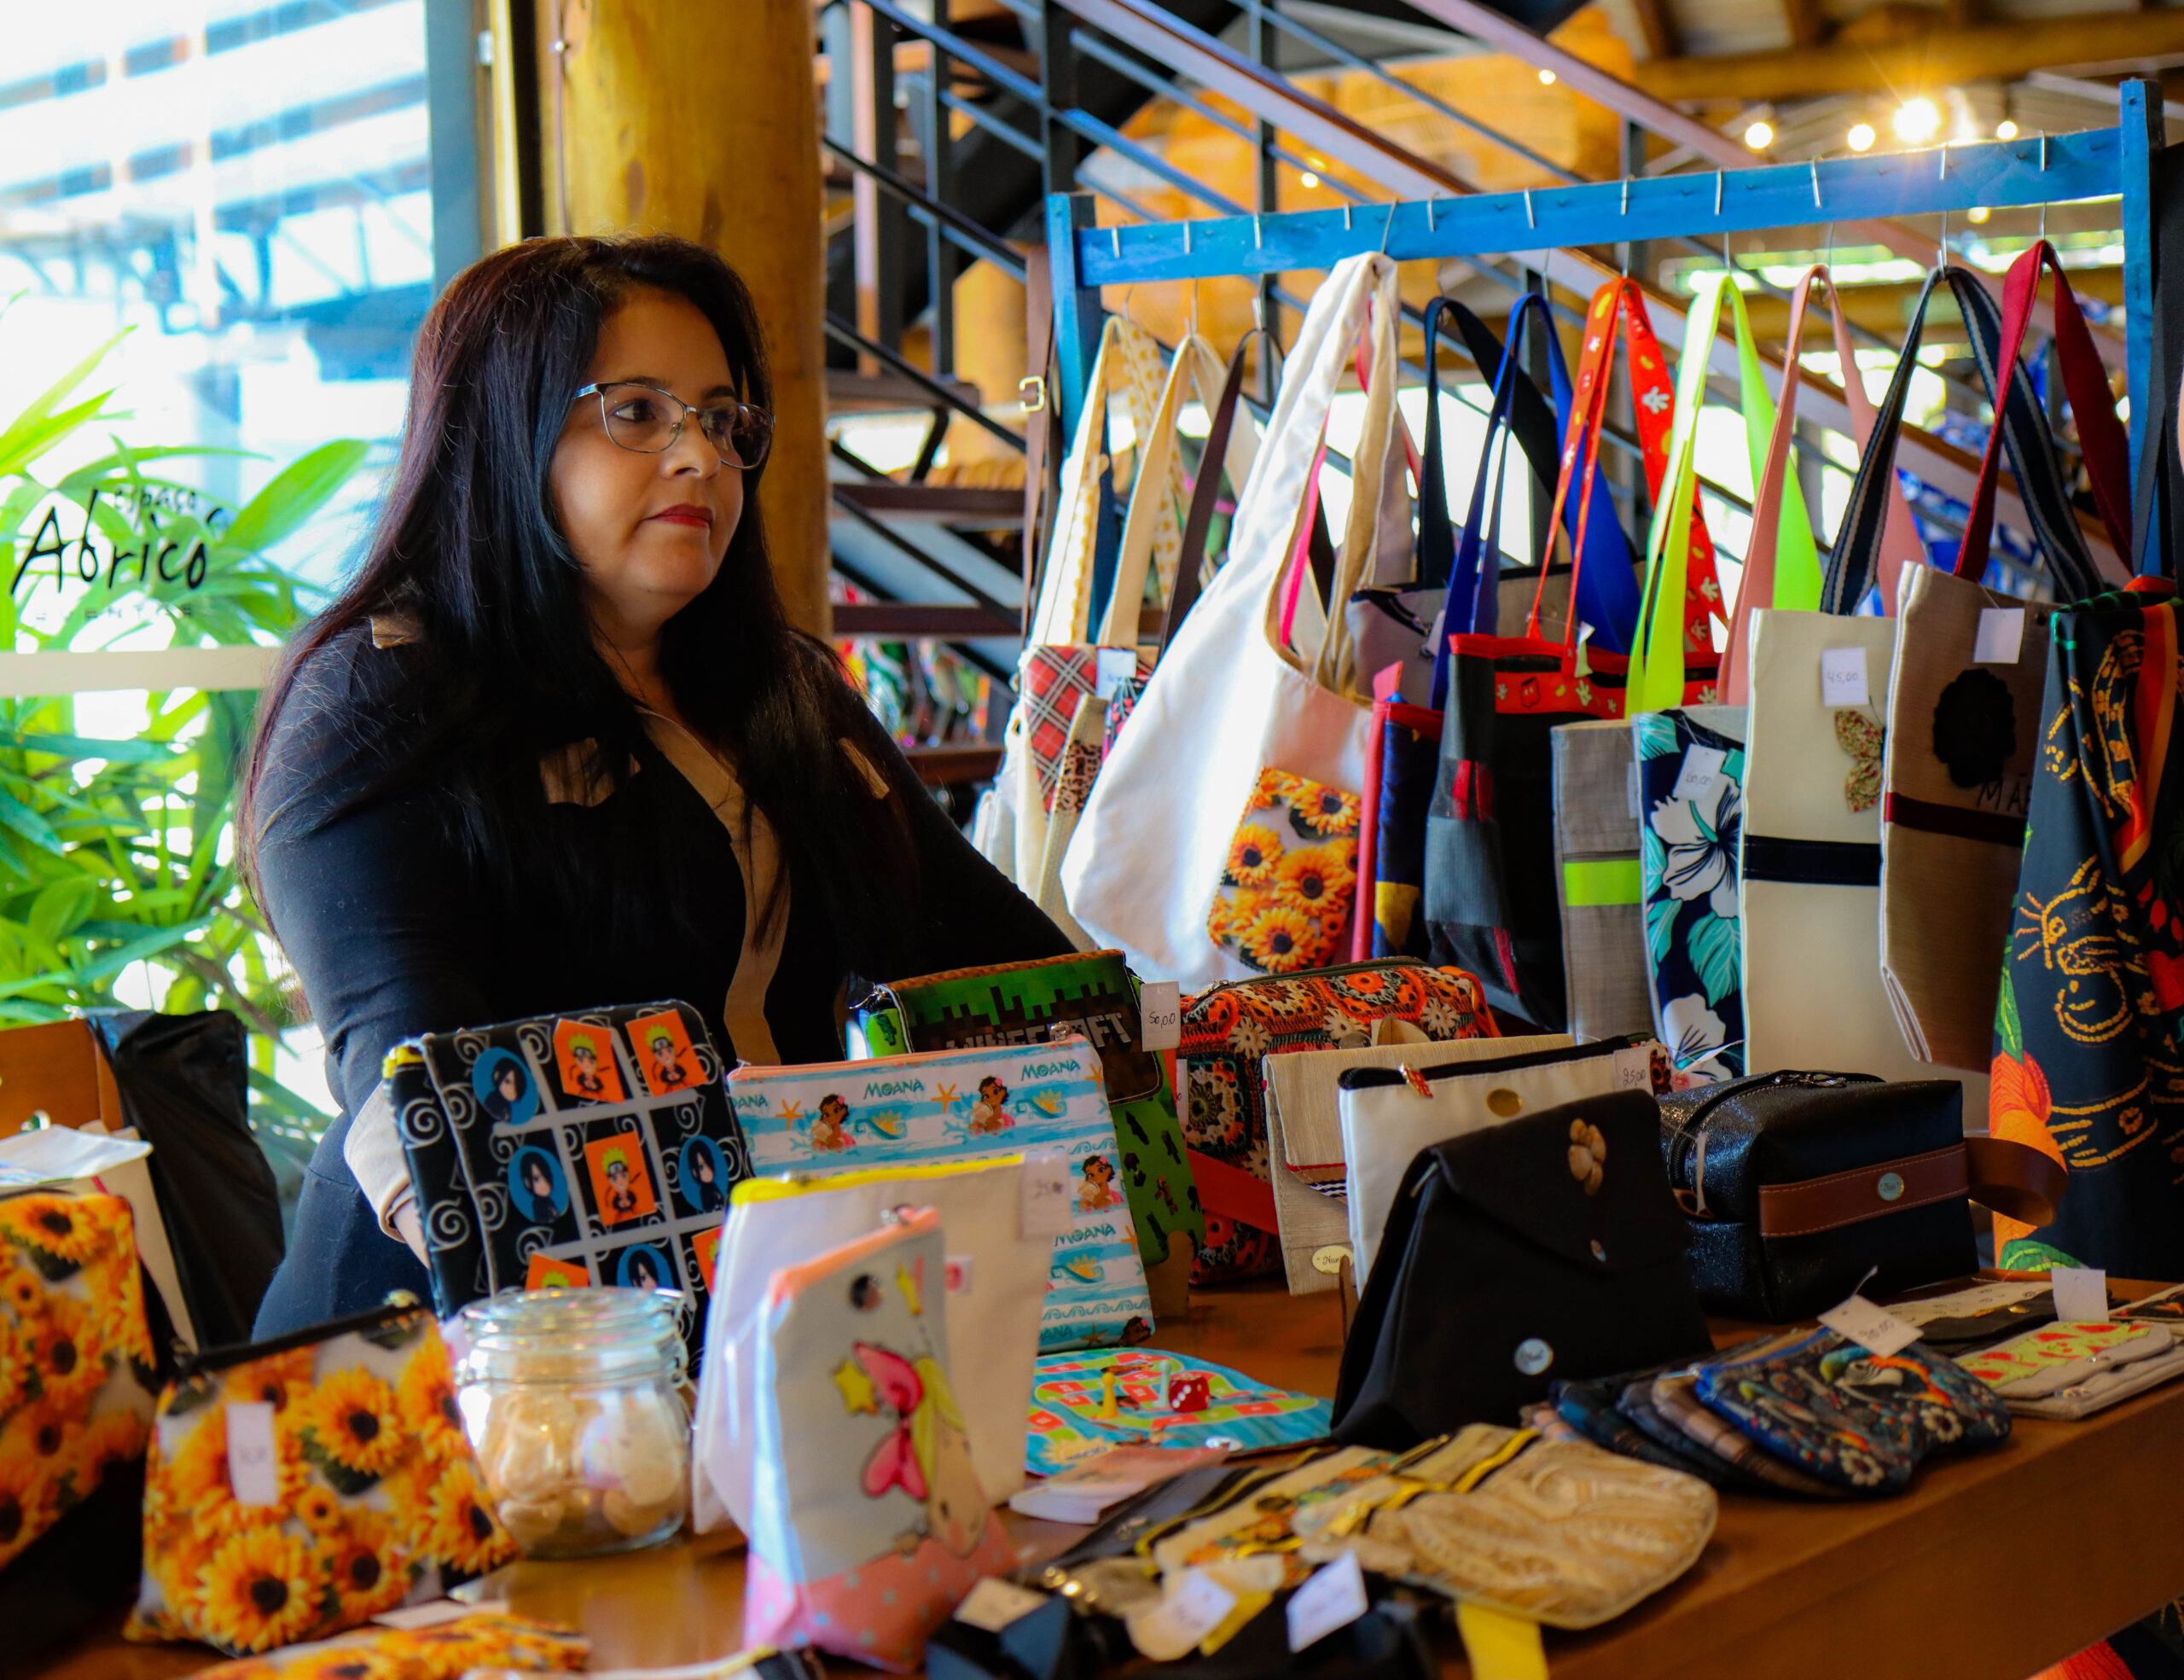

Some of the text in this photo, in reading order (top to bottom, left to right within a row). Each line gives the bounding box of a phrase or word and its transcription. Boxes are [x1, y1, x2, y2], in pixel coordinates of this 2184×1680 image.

[1020, 1059, 1081, 1081] MOANA
[863, 1078, 925, 1100] MOANA
[732, 1093, 770, 1110] ANA
[1054, 1223, 1117, 1247] MOANA
